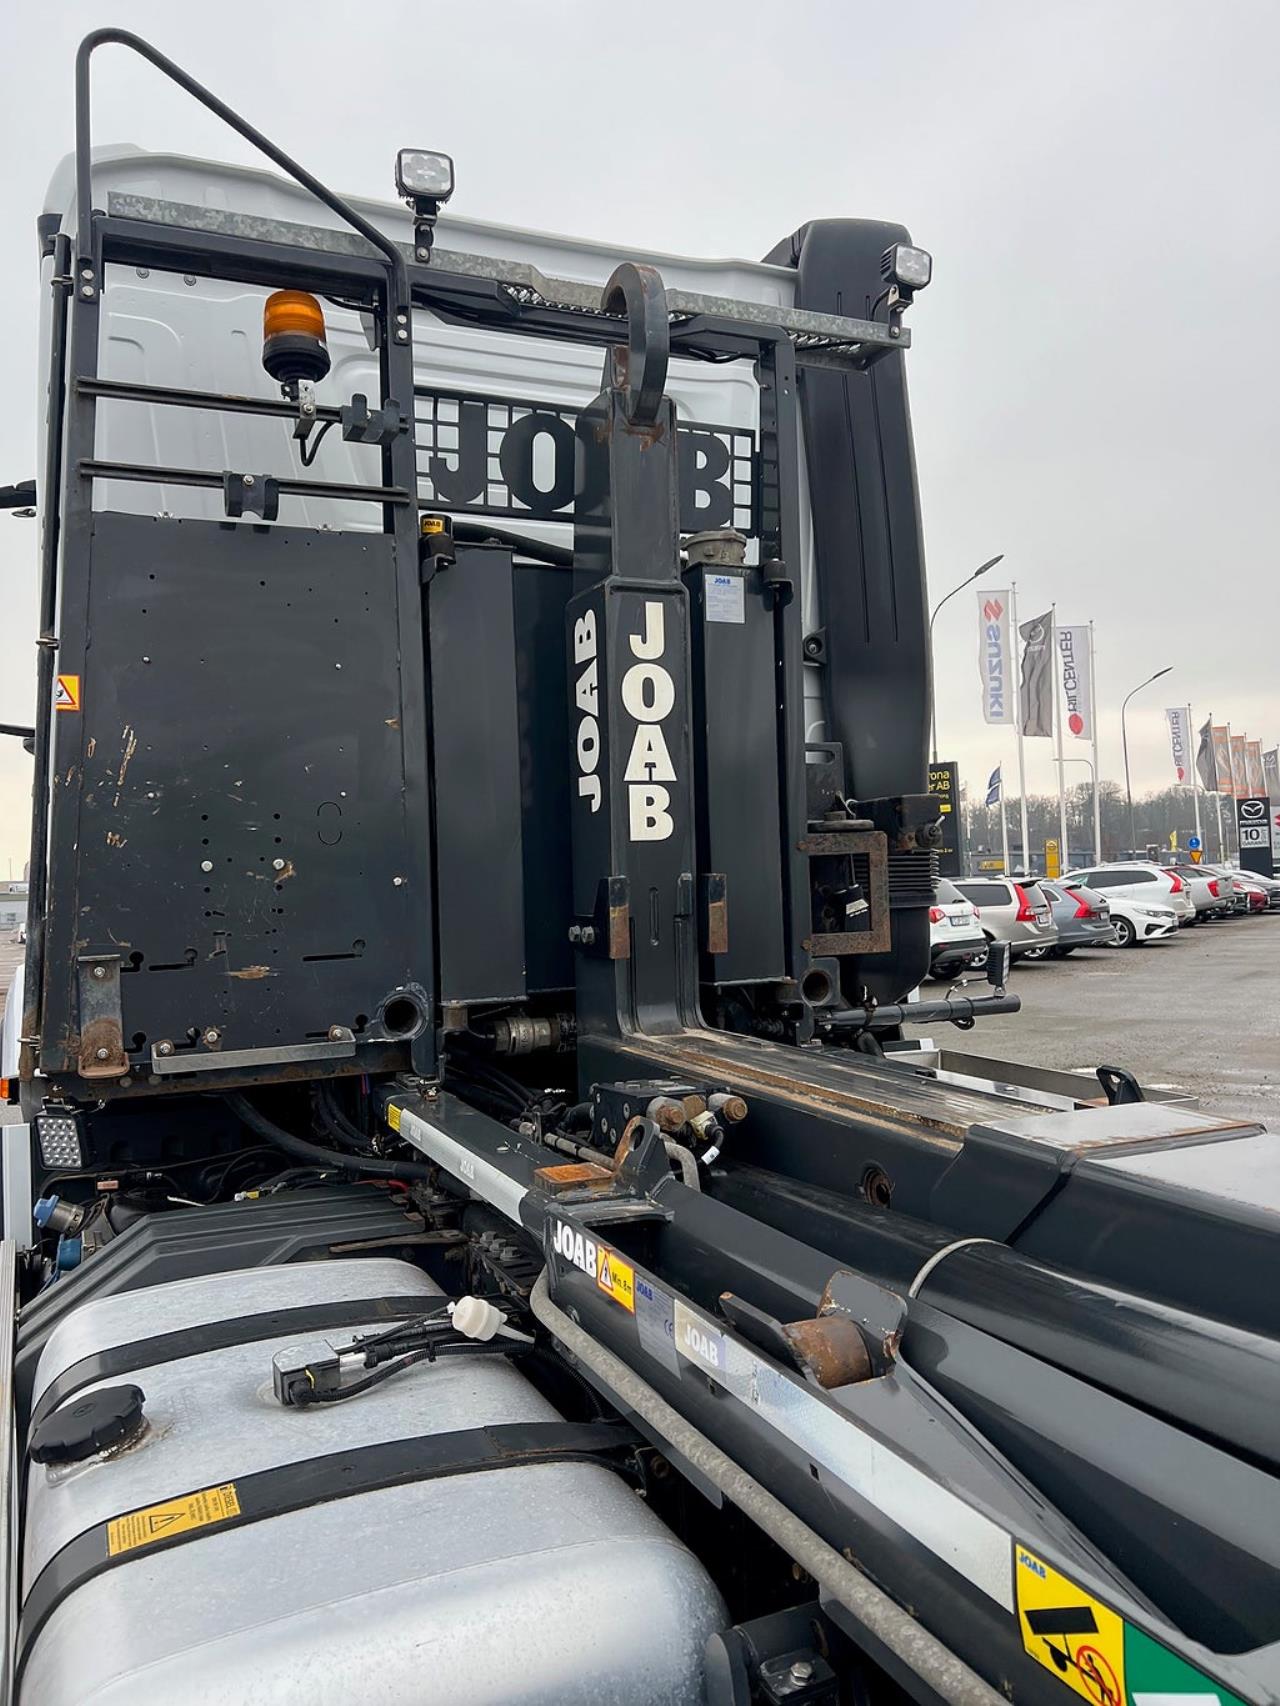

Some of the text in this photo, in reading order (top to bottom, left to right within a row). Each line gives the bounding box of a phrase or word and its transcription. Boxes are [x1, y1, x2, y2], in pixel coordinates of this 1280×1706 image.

[429, 400, 731, 532] JOB
[574, 609, 601, 813] JOAB
[622, 601, 677, 841] JOAB
[936, 781, 950, 790] AB
[1242, 829, 1260, 841] 10
[554, 1220, 597, 1278] JOAB
[685, 1325, 719, 1366] JOAB
[1019, 1553, 1046, 1578] JOAB
